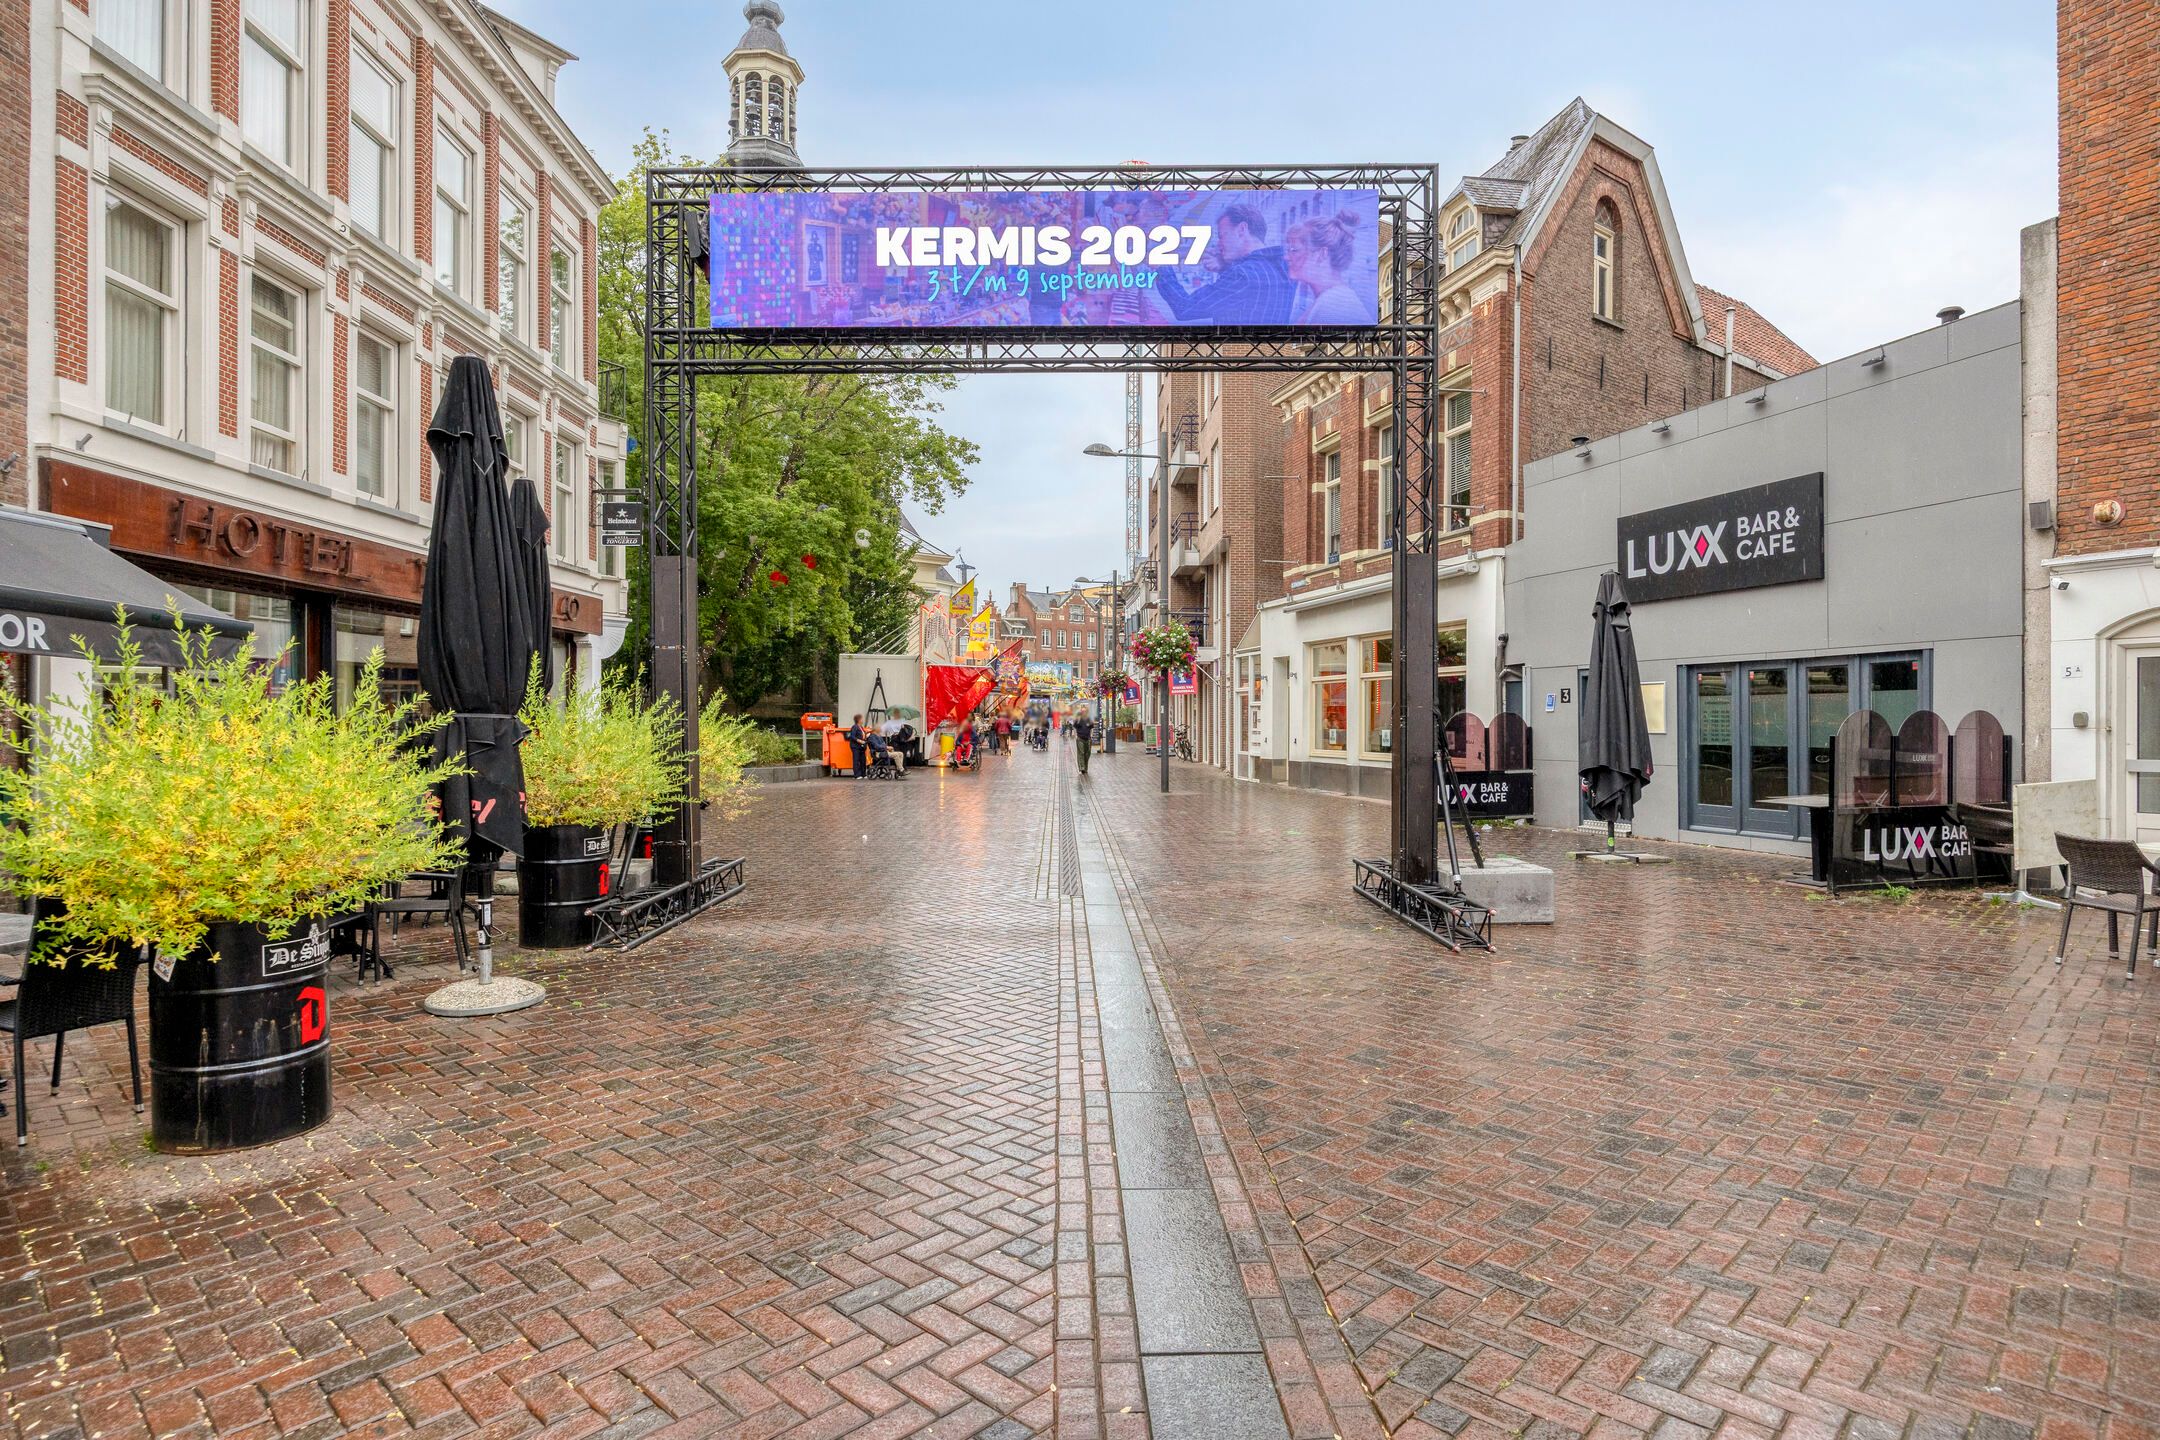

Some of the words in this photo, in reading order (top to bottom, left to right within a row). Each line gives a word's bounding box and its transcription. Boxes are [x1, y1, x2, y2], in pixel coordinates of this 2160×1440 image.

[876, 226, 1072, 267] KERMIS
[1080, 225, 1212, 266] 2027
[927, 269, 940, 302] 3
[949, 265, 1008, 297] t/m
[1016, 269, 1030, 297] 9
[1040, 262, 1159, 302] september
[607, 517, 638, 525] Heineken
[170, 498, 372, 582] HOTEL
[1627, 520, 1729, 579] LUXX
[1736, 531, 1796, 561] CAFE
[1562, 689, 1569, 702] 3
[1480, 792, 1507, 803] CAFE
[1864, 826, 1937, 862] LUXX
[1941, 825, 1968, 840] BAR
[1941, 841, 1972, 857] CAF
[269, 947, 298, 968] De
